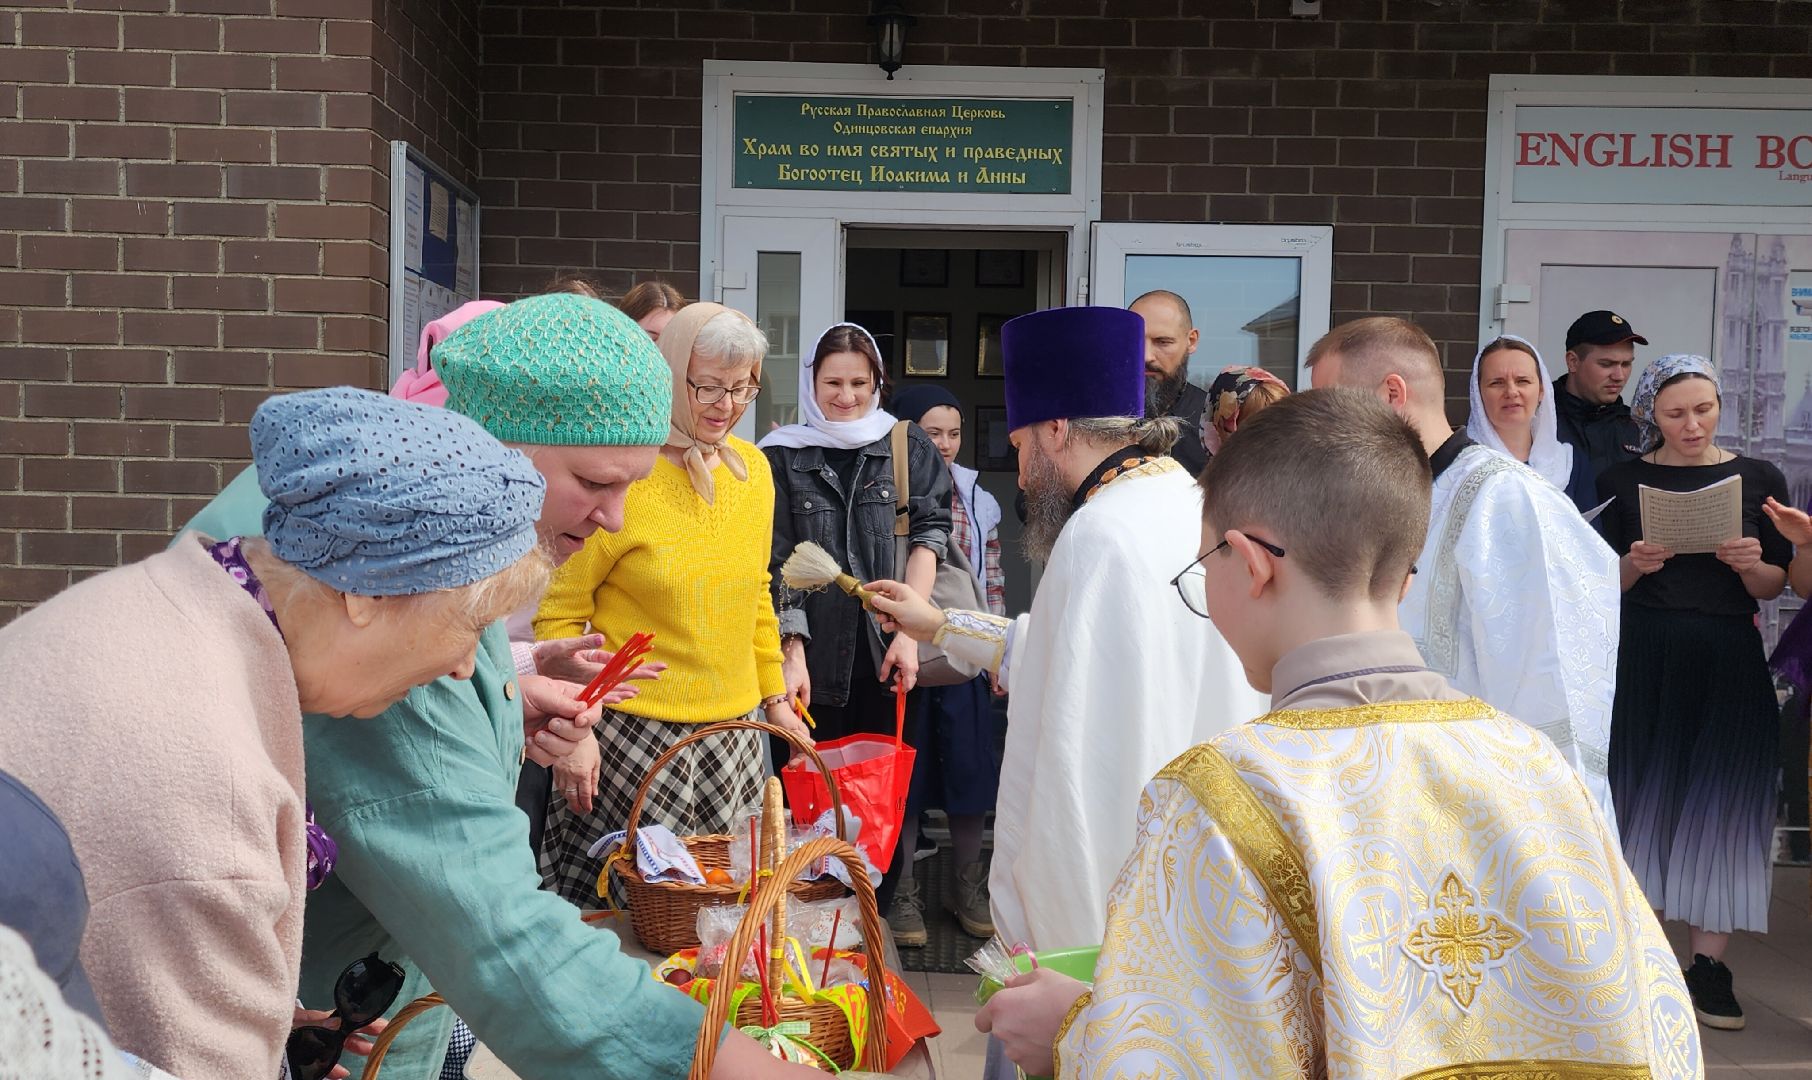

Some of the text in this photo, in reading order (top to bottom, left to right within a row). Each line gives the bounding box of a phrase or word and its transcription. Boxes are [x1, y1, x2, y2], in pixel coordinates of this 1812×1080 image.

[801, 102, 1006, 121] Русская Православная Церковь
[833, 121, 972, 138] Одинцовская епархия
[743, 138, 1063, 165] Храм во имя святых и праведных
[1515, 132, 1734, 169] ENGLISH
[778, 163, 1026, 185] Богоотец Иоакима и Анны
